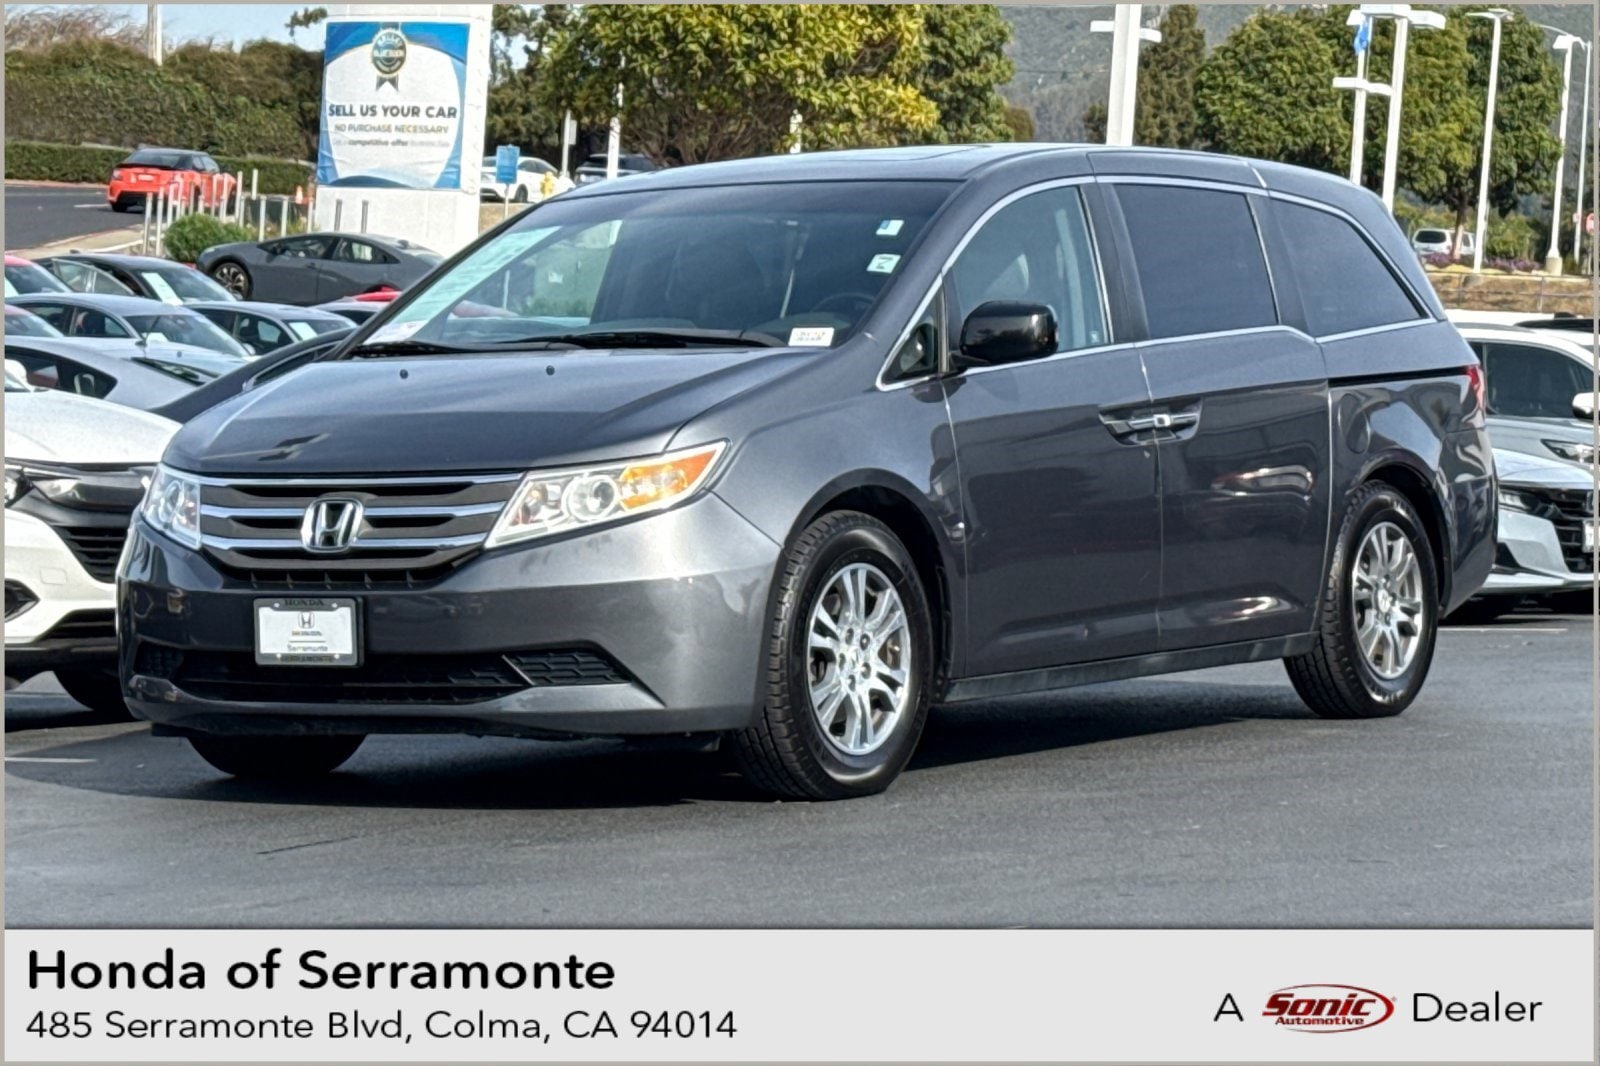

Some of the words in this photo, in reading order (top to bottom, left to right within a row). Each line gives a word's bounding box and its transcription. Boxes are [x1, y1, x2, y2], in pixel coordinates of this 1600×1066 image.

[328, 104, 356, 117] SELL
[360, 104, 377, 117] US
[382, 104, 420, 117] YOUR
[425, 105, 457, 119] CAR
[334, 124, 346, 132] NO
[347, 123, 392, 133] PURCHASE
[394, 124, 449, 134] NECESSARY
[287, 644, 328, 652] Serramonte
